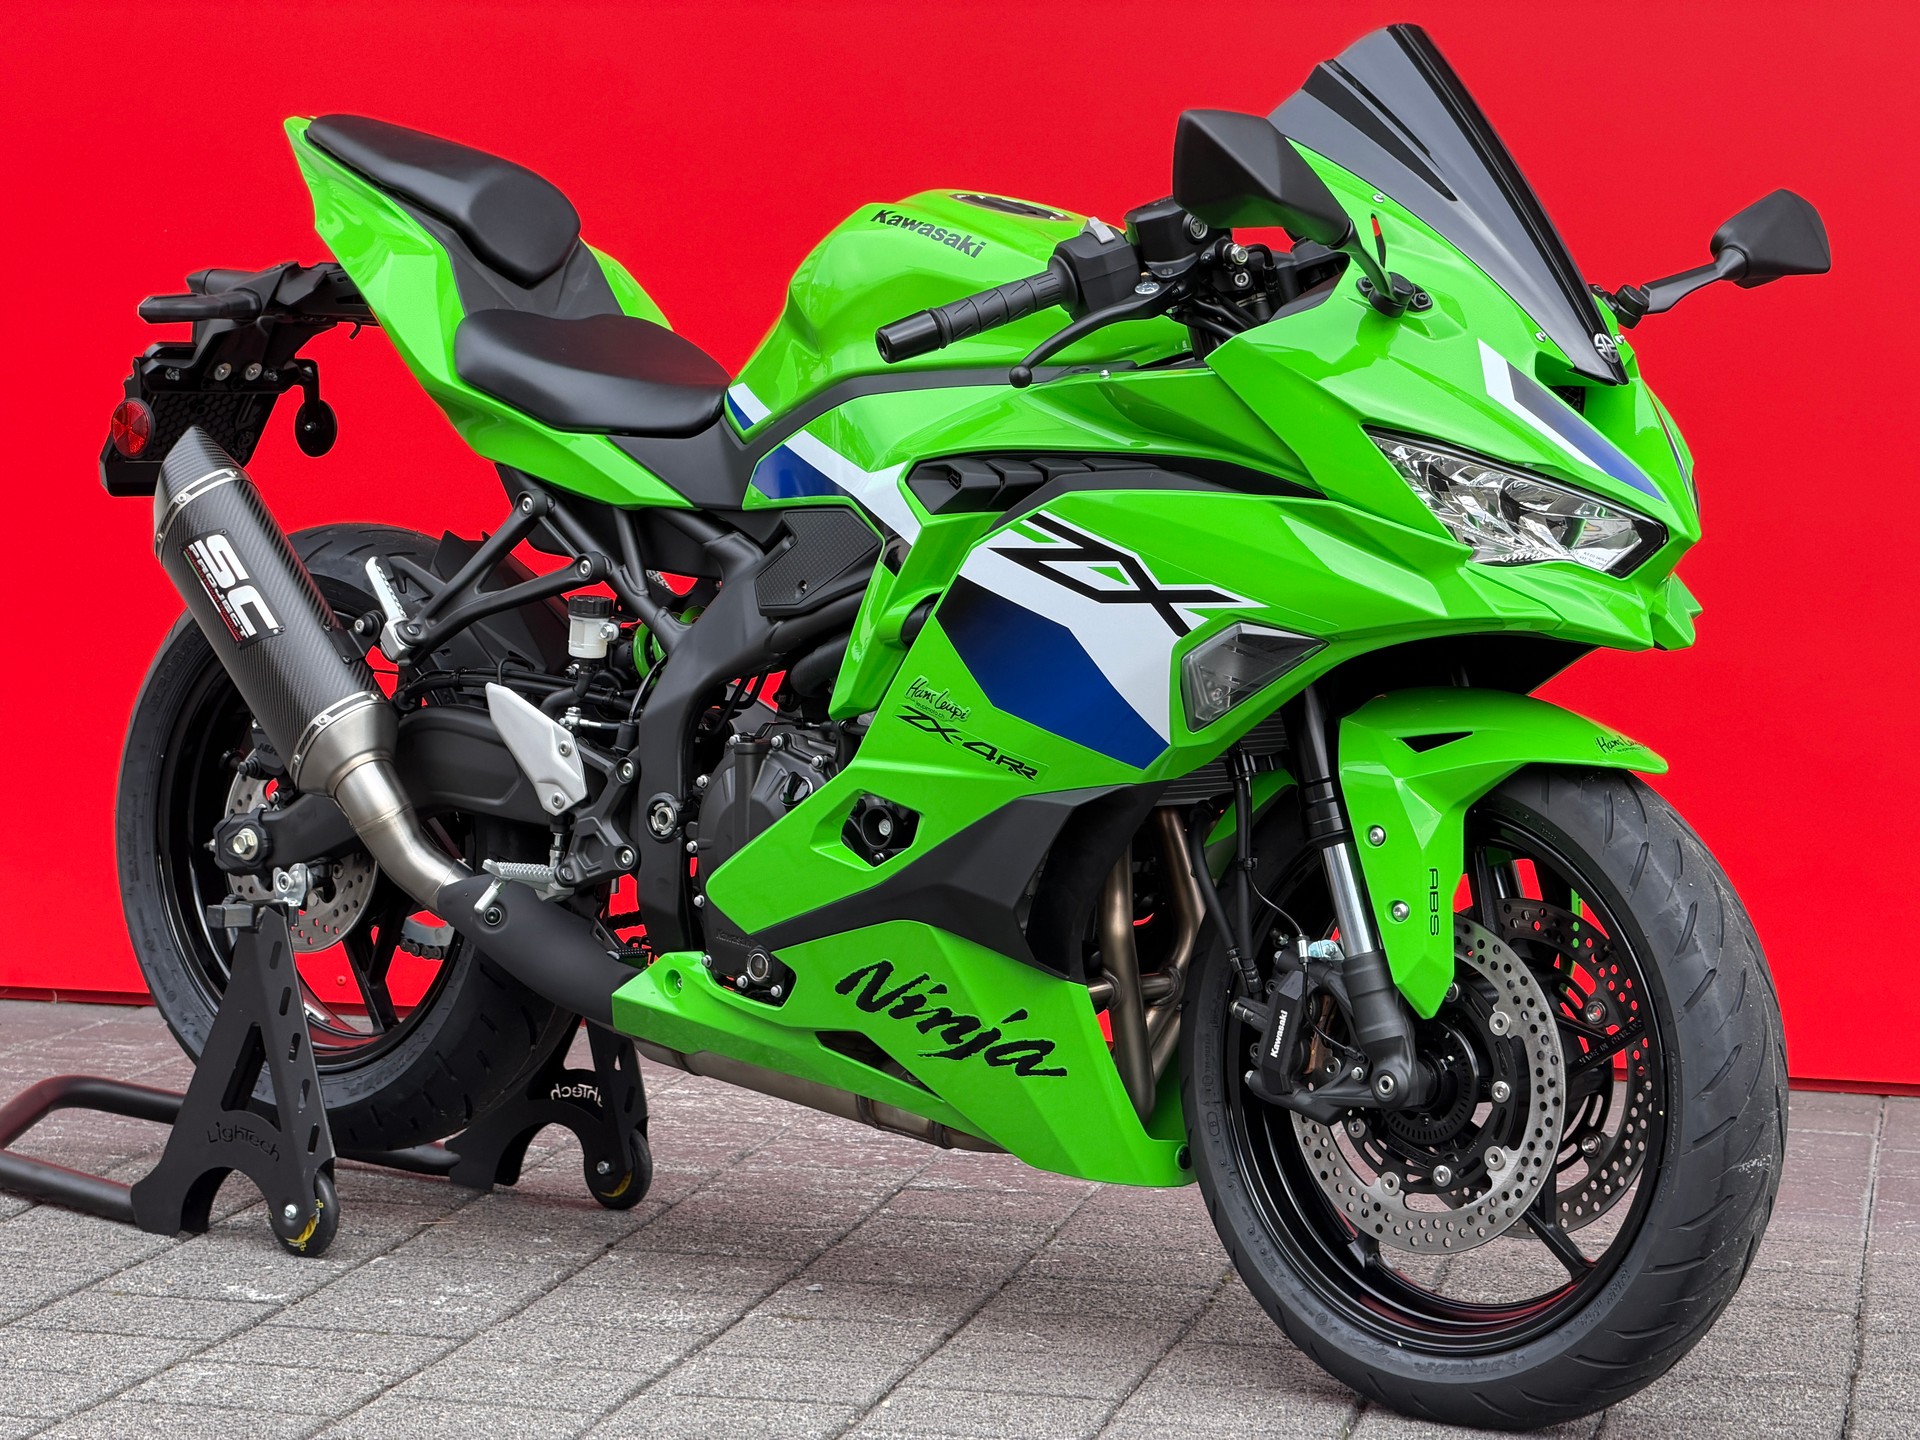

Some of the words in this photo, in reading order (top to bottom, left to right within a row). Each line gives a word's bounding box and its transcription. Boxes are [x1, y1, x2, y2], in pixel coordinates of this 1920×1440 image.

[870, 209, 986, 258] Kawasaki
[187, 543, 248, 640] PROJECT
[193, 534, 279, 636] SC
[987, 512, 1243, 637] ZX
[906, 678, 936, 704] Hans
[934, 690, 970, 720] Leupi
[895, 705, 1038, 781] ZX-4RR
[1429, 868, 1439, 936] ABS
[835, 960, 1068, 1077] Ninja
[1270, 1009, 1288, 1058] Kawasaki
[207, 1122, 280, 1162] LighTech
